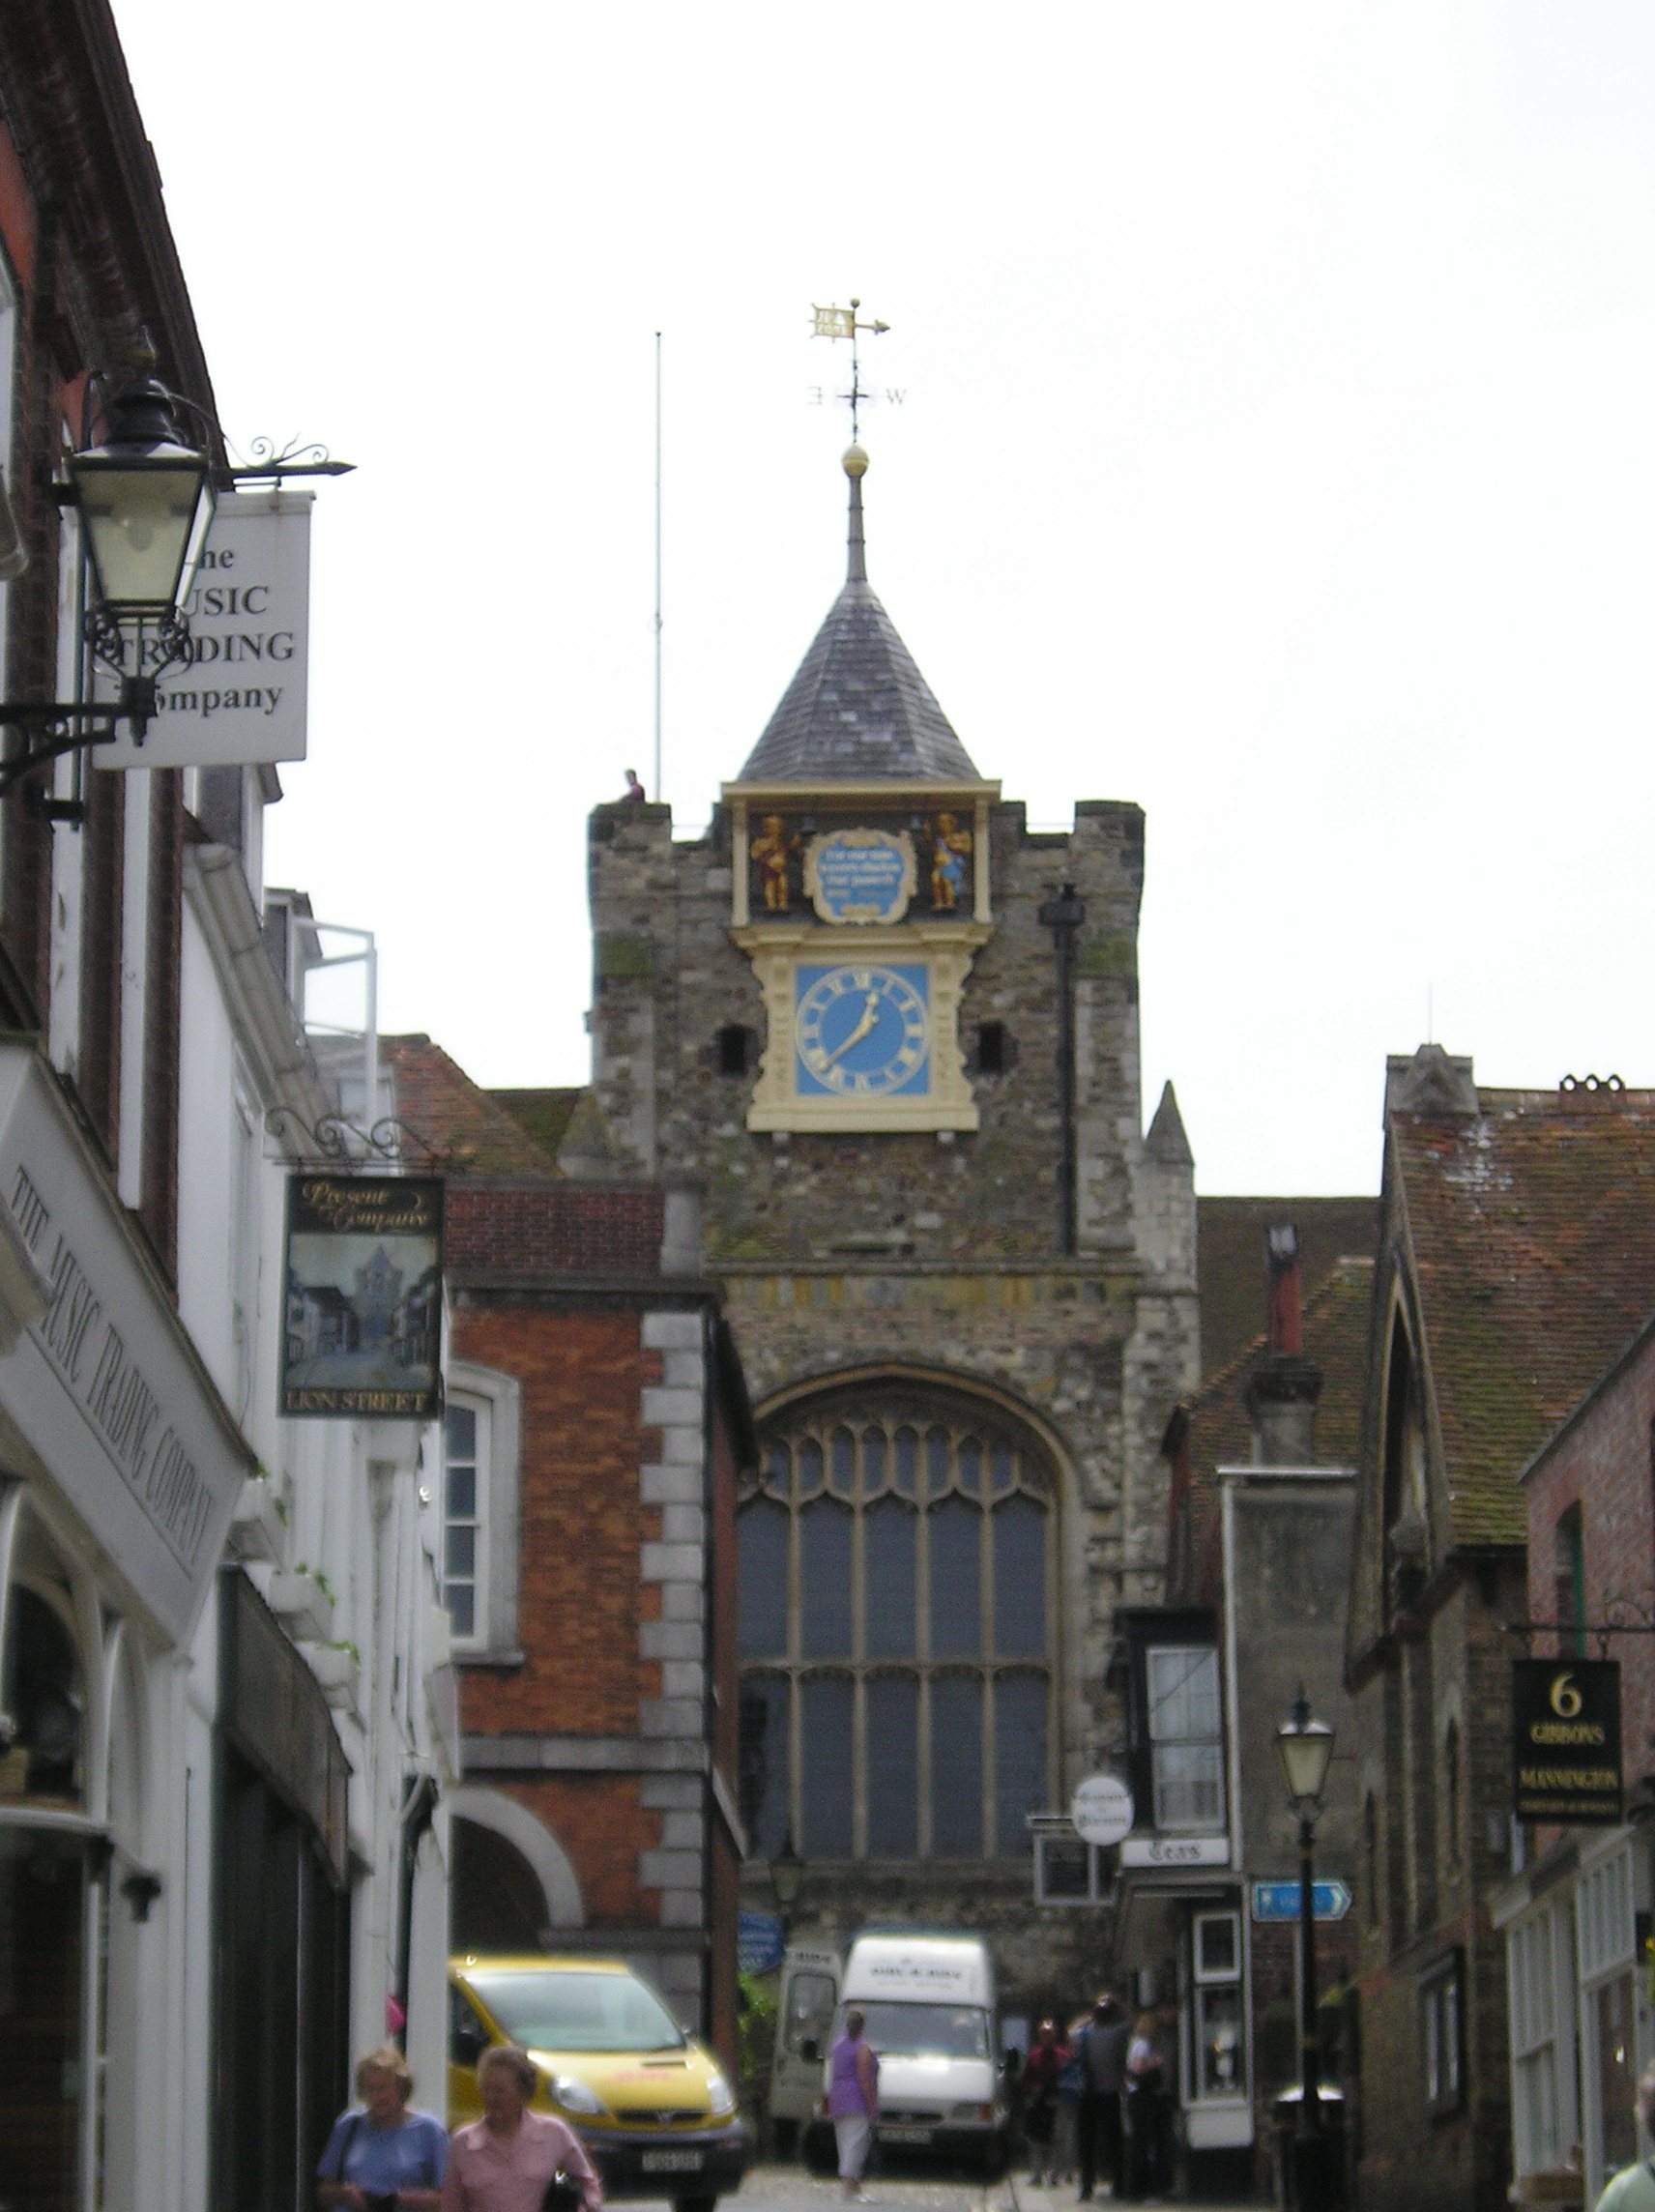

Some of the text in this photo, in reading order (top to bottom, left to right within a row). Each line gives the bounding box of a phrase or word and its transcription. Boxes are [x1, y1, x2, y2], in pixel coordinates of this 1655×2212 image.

[197, 548, 234, 569] he
[189, 585, 271, 617] USIC
[87, 1322, 159, 1481] TRADING
